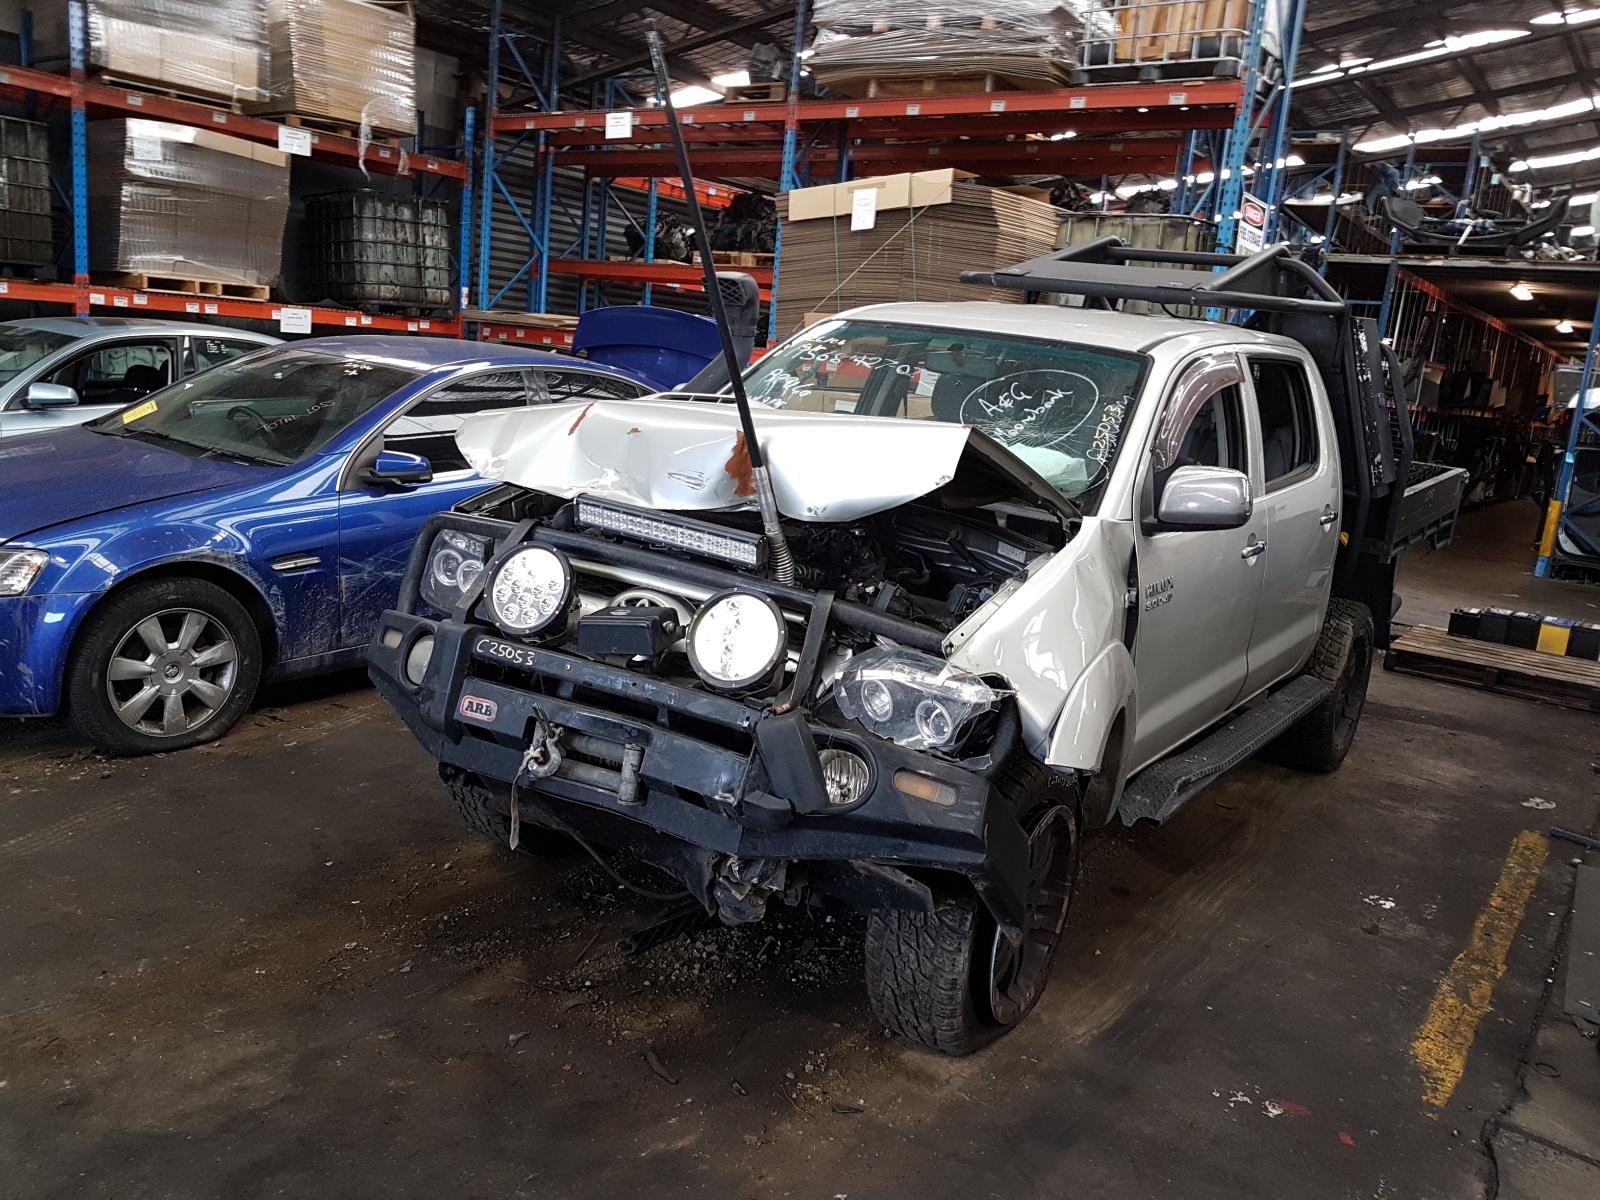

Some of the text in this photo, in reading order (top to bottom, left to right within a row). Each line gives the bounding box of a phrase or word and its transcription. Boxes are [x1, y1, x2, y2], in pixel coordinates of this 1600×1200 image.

[305, 400, 336, 415] LOSS
[1144, 575, 1174, 600] HILUX
[476, 639, 536, 666] C25053
[464, 700, 492, 717] ARB
